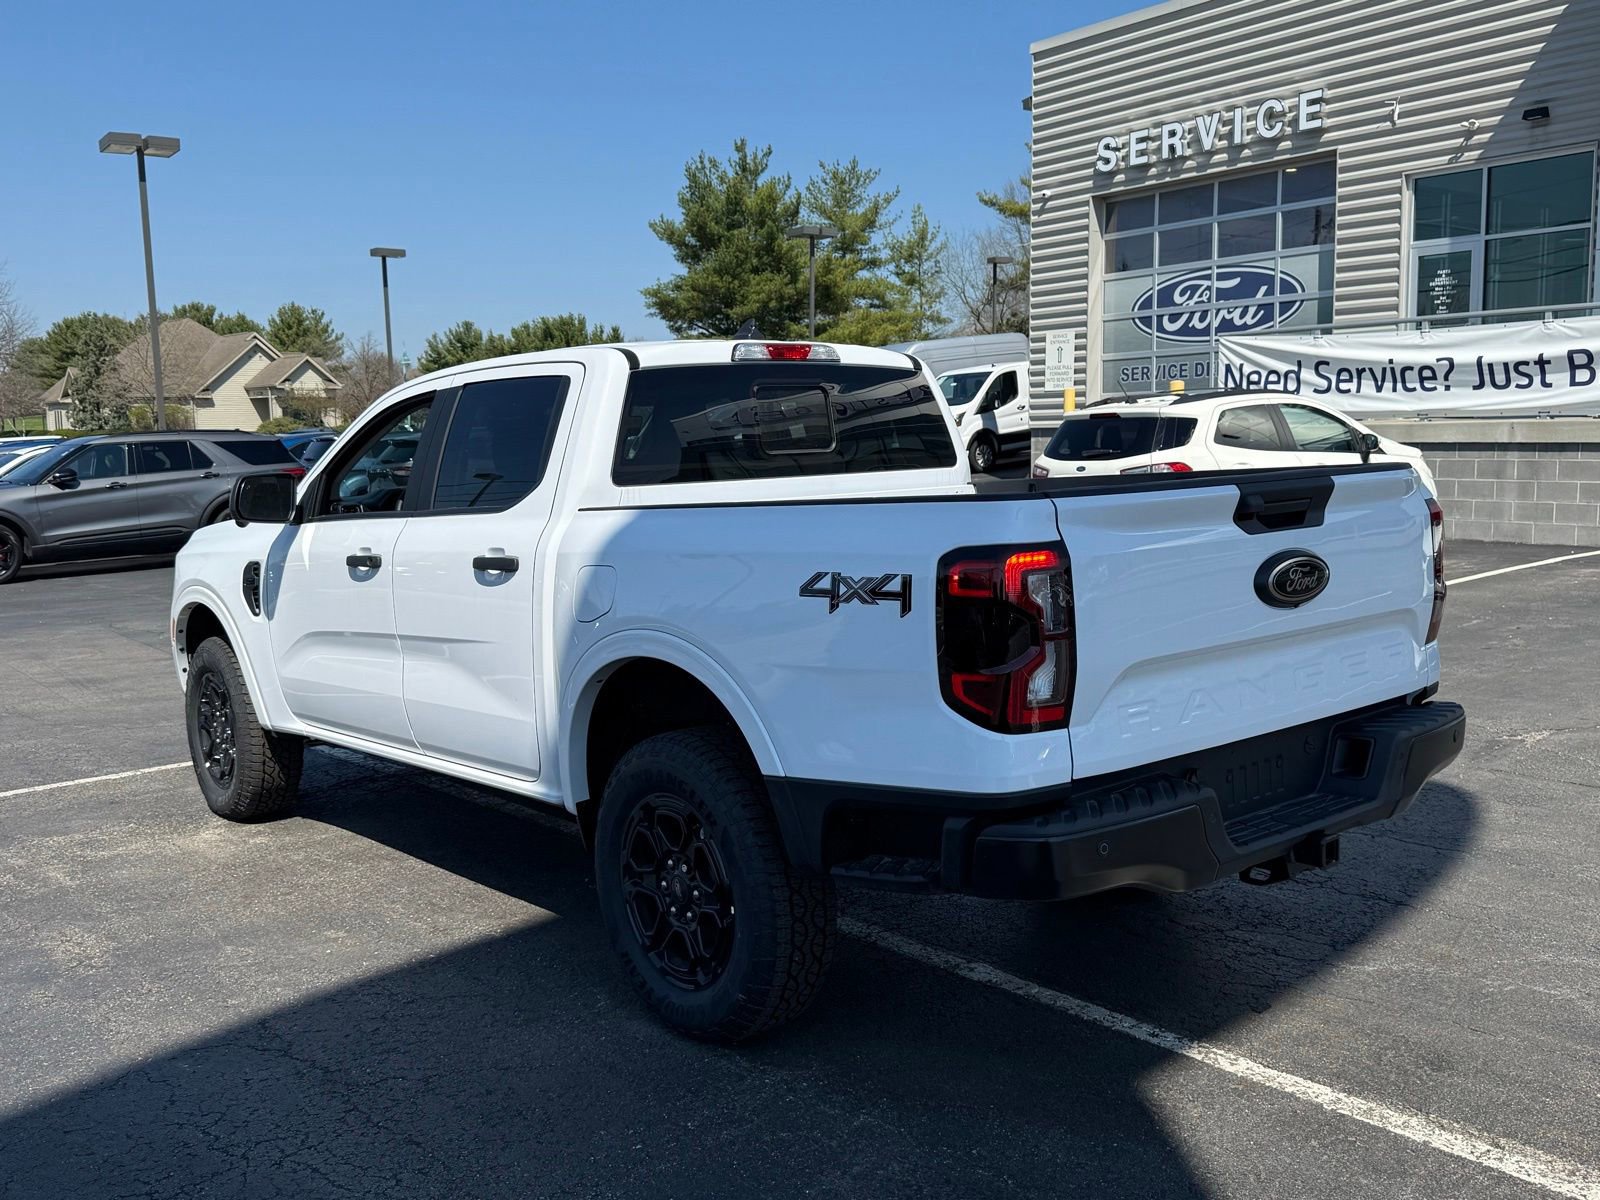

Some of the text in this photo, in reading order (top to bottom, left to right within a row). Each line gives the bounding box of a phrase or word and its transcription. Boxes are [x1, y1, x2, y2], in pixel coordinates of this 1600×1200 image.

[1095, 88, 1325, 173] SERVICE
[1162, 277, 1268, 332] Ford
[1120, 363, 1188, 382] SERVICE
[1224, 360, 1302, 395] Need
[1312, 357, 1455, 395] Service?
[1472, 353, 1553, 391] Just
[1116, 638, 1408, 738] RANGER
